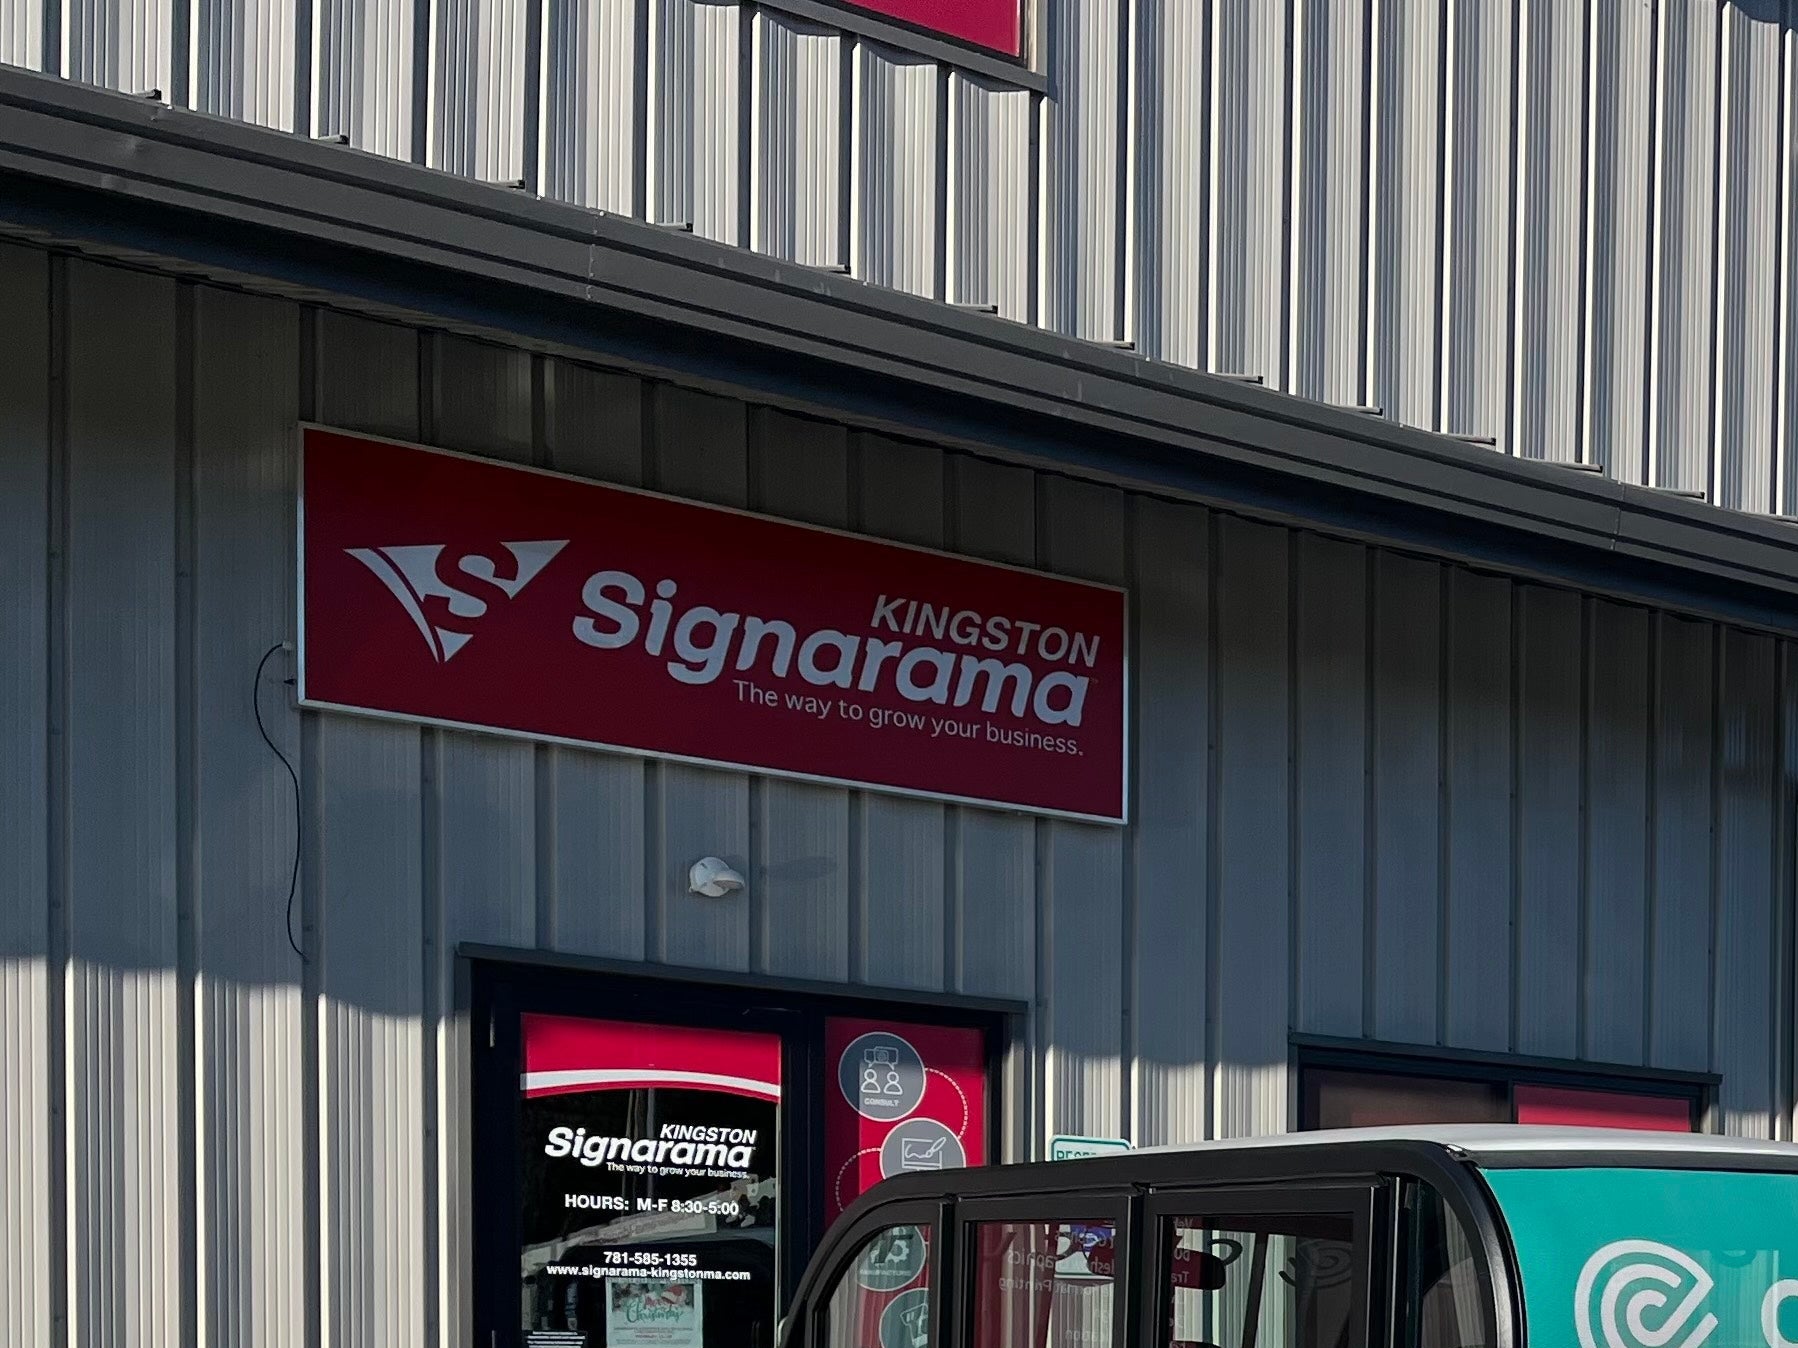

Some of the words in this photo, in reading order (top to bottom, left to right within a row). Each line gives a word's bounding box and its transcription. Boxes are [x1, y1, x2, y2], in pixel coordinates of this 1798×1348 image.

[869, 595, 1100, 668] KINGSTON
[572, 570, 1089, 727] Signarama
[733, 679, 779, 707] The
[785, 690, 831, 718] way
[839, 698, 862, 718] to
[868, 704, 925, 732] grow
[930, 714, 981, 740] your
[985, 721, 1083, 756] business.
[660, 1124, 757, 1144] KINGSTON
[545, 1127, 752, 1168] Signarama
[606, 1162, 624, 1171] The
[627, 1165, 645, 1175] way
[648, 1165, 658, 1174] to
[660, 1167, 682, 1177] grow
[684, 1168, 706, 1177] your
[707, 1168, 750, 1179] business.
[565, 1194, 629, 1210] HOURS:
[637, 1198, 668, 1211] M-F
[671, 1200, 739, 1215] 8:30-5:00
[604, 1251, 697, 1266] 781-585-1355
[547, 1264, 750, 1281] www.signarama-kingstonma.com
